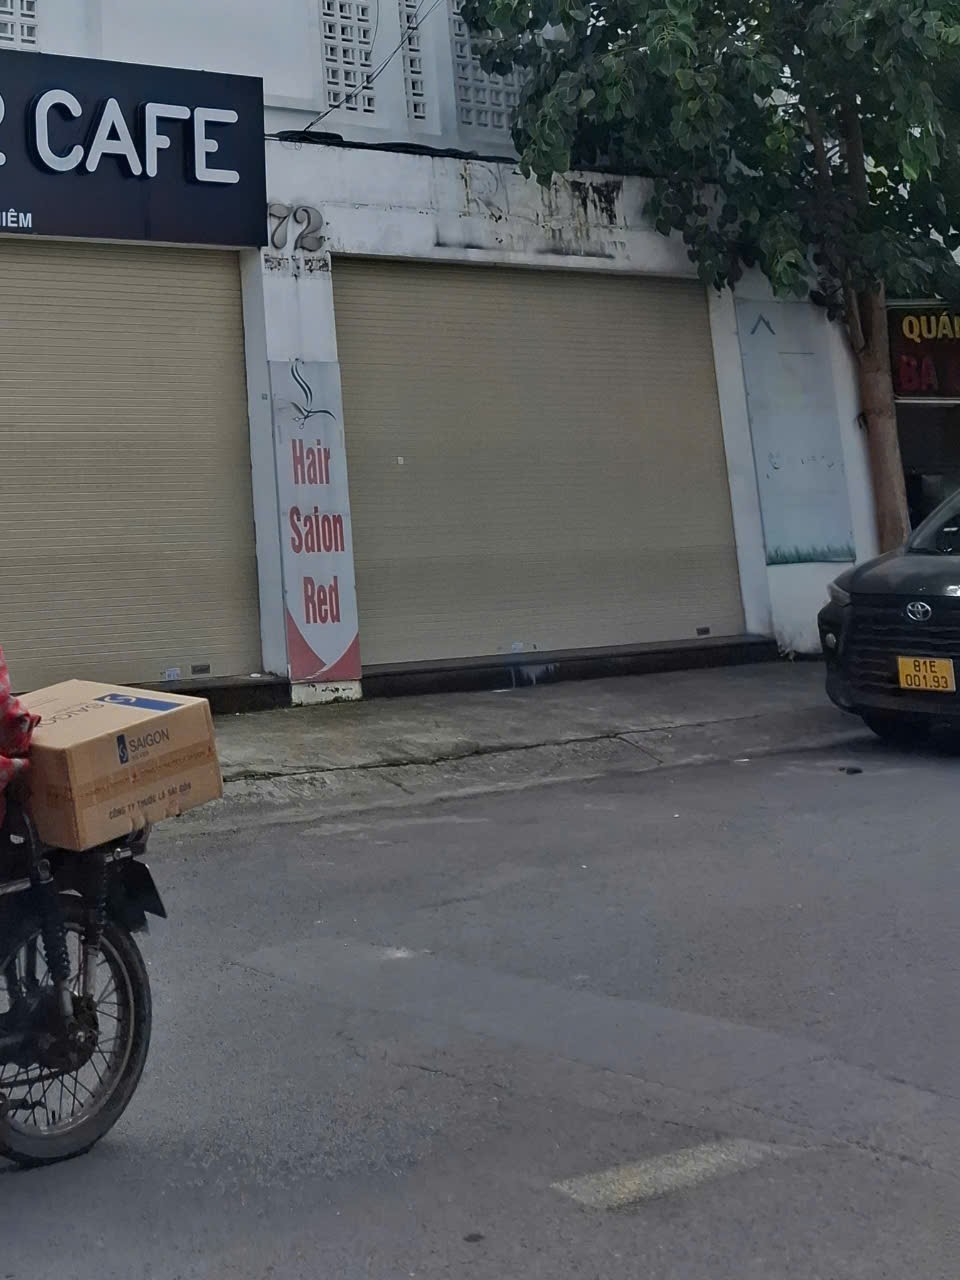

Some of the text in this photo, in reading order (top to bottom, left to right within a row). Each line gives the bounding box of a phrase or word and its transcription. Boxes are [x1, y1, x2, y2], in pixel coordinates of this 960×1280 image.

[34, 88, 240, 184] CAFE
[269, 203, 325, 253] 72
[291, 438, 331, 485] Hair
[302, 576, 341, 624] Red
[905, 673, 949, 689] 001.93
[913, 659, 938, 673] 81E
[129, 728, 170, 753] SAIGON
